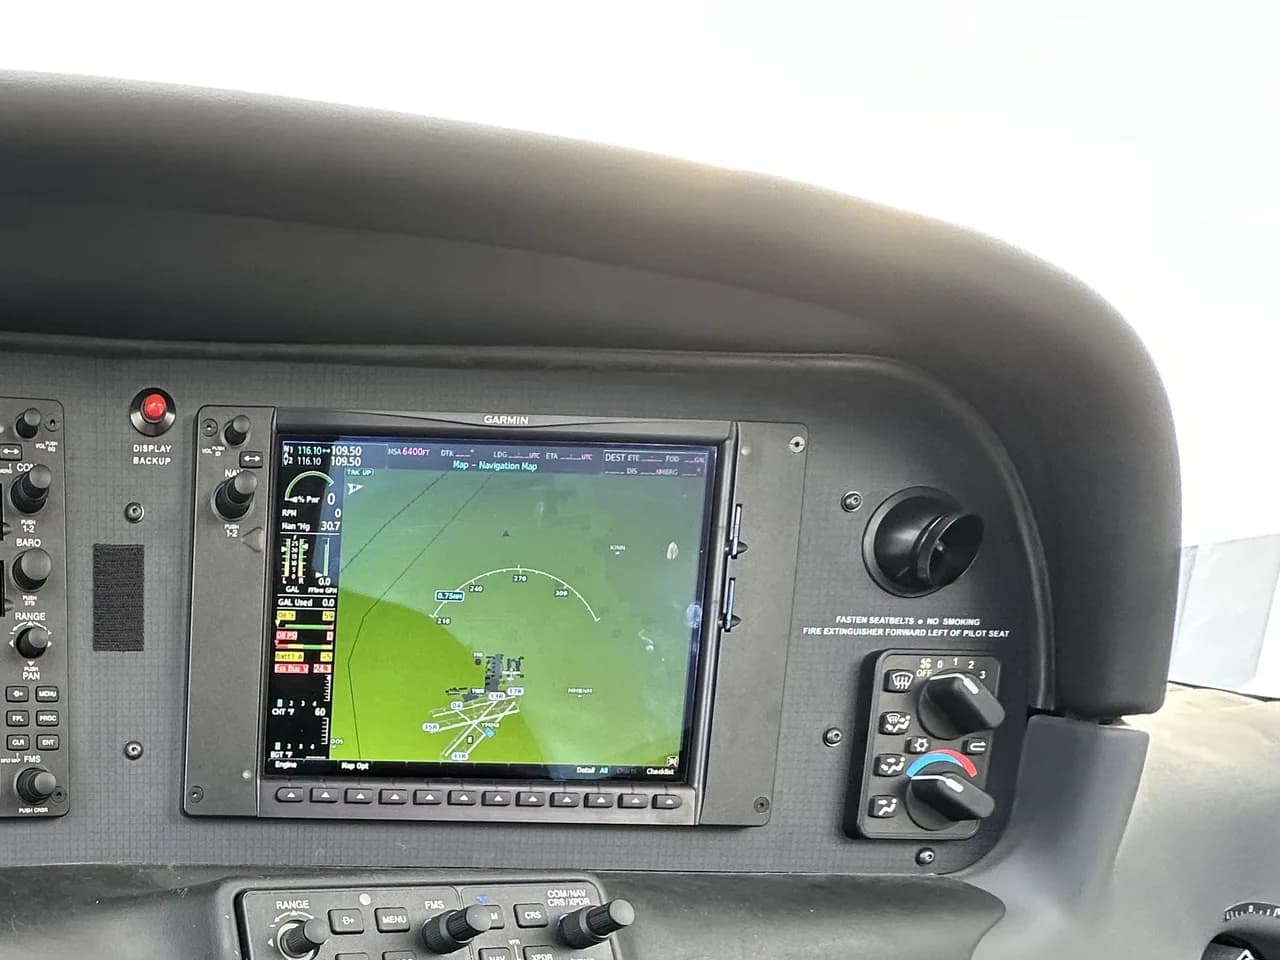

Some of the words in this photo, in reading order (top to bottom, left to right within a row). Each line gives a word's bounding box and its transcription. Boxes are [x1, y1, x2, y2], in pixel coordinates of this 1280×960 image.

[484, 415, 528, 425] GARMIN
[133, 444, 172, 453] DISPLAY
[133, 457, 170, 465] BACKUP
[453, 461, 469, 470] Map
[479, 462, 519, 471] Navigation
[522, 462, 537, 471] Map
[16, 538, 41, 547] BARO
[16, 612, 46, 620] RANGE
[869, 617, 914, 625] SEATBELTS
[824, 628, 883, 636] EXTINGUISHER
[885, 628, 926, 637] FORWARD
[928, 629, 948, 637] LEFT
[950, 629, 961, 637] OF
[963, 630, 987, 638] PILOT
[988, 630, 1009, 638] SEAT
[23, 672, 40, 680] PAN
[547, 890, 586, 900] COM/NAV
[276, 900, 309, 909] RANGE
[425, 901, 444, 909] FMS
[382, 914, 406, 924] MENU
